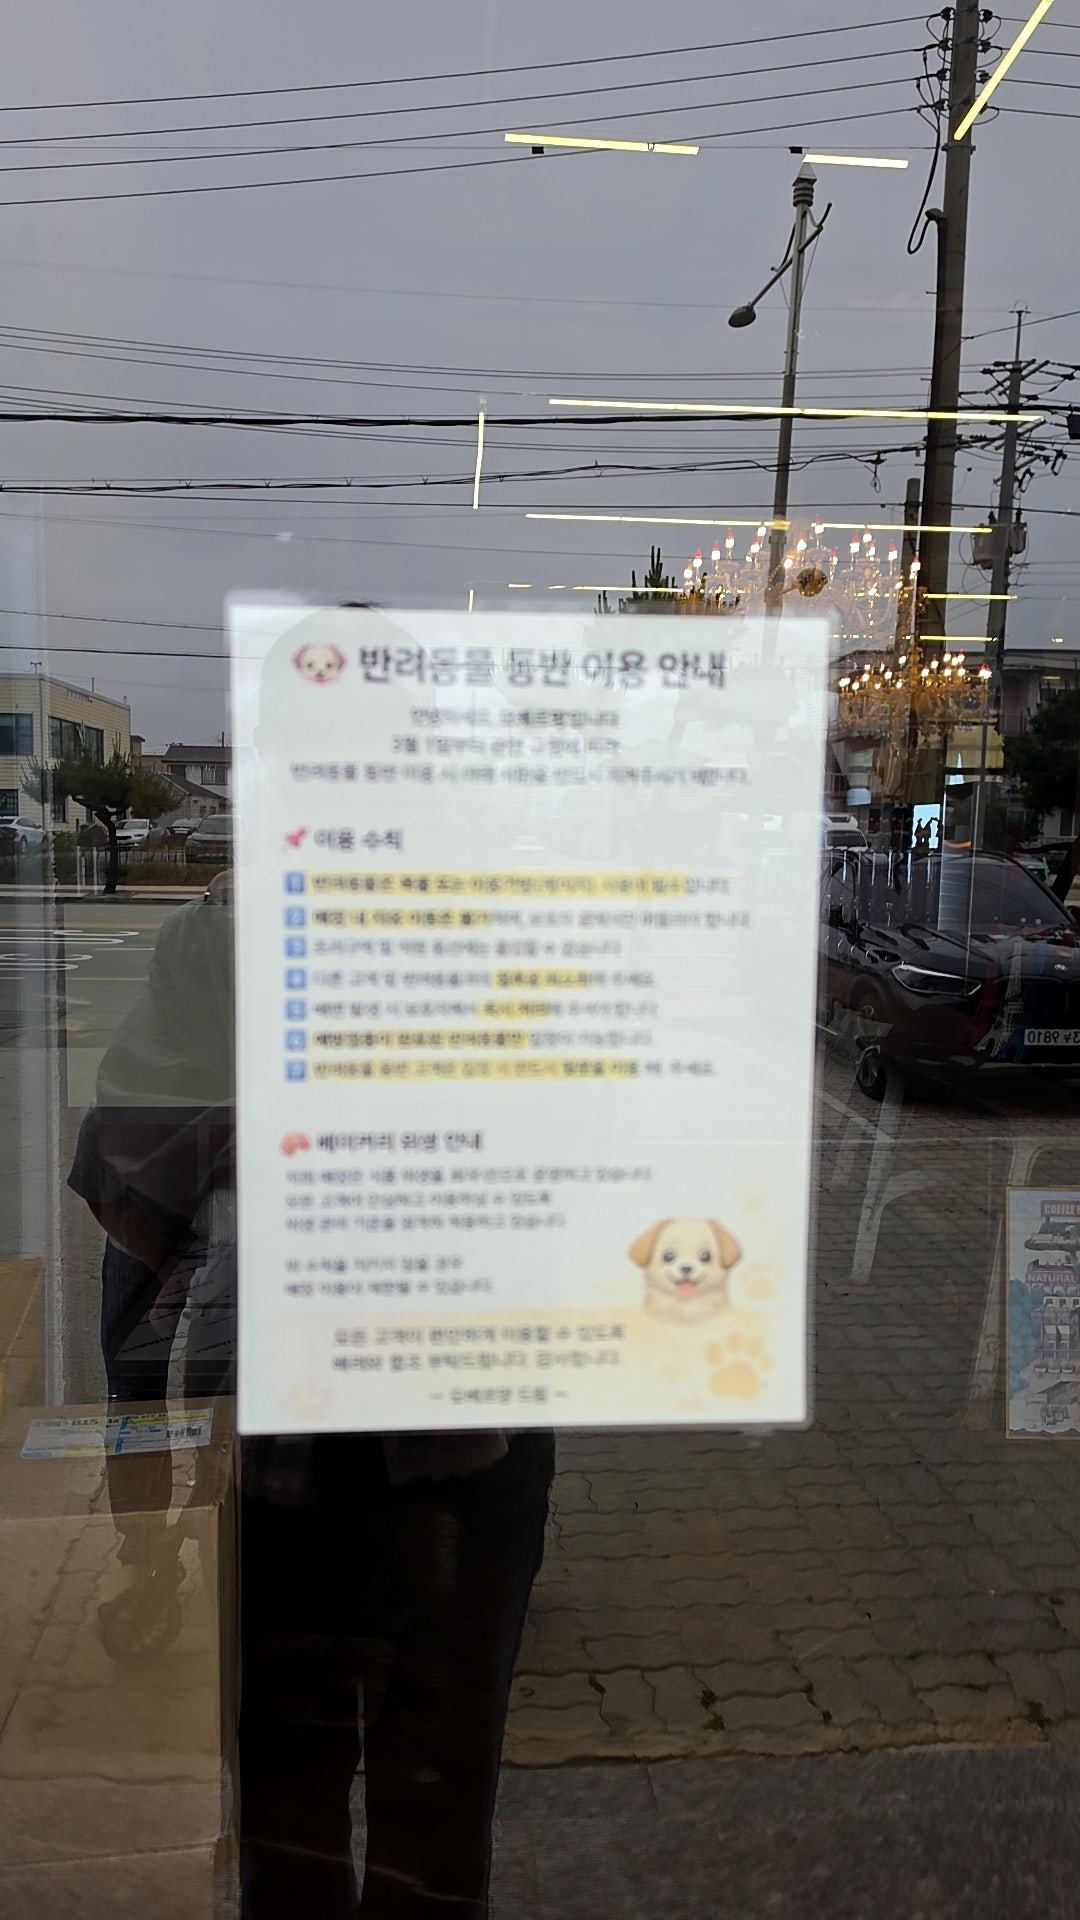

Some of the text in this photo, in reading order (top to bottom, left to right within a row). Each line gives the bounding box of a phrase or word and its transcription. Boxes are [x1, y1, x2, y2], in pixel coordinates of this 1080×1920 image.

[359, 645, 730, 689] 반려동물 동반 이용 안내
[315, 828, 403, 853] 이용 수칙
[316, 1131, 483, 1153] 베이커리 위생 안내
